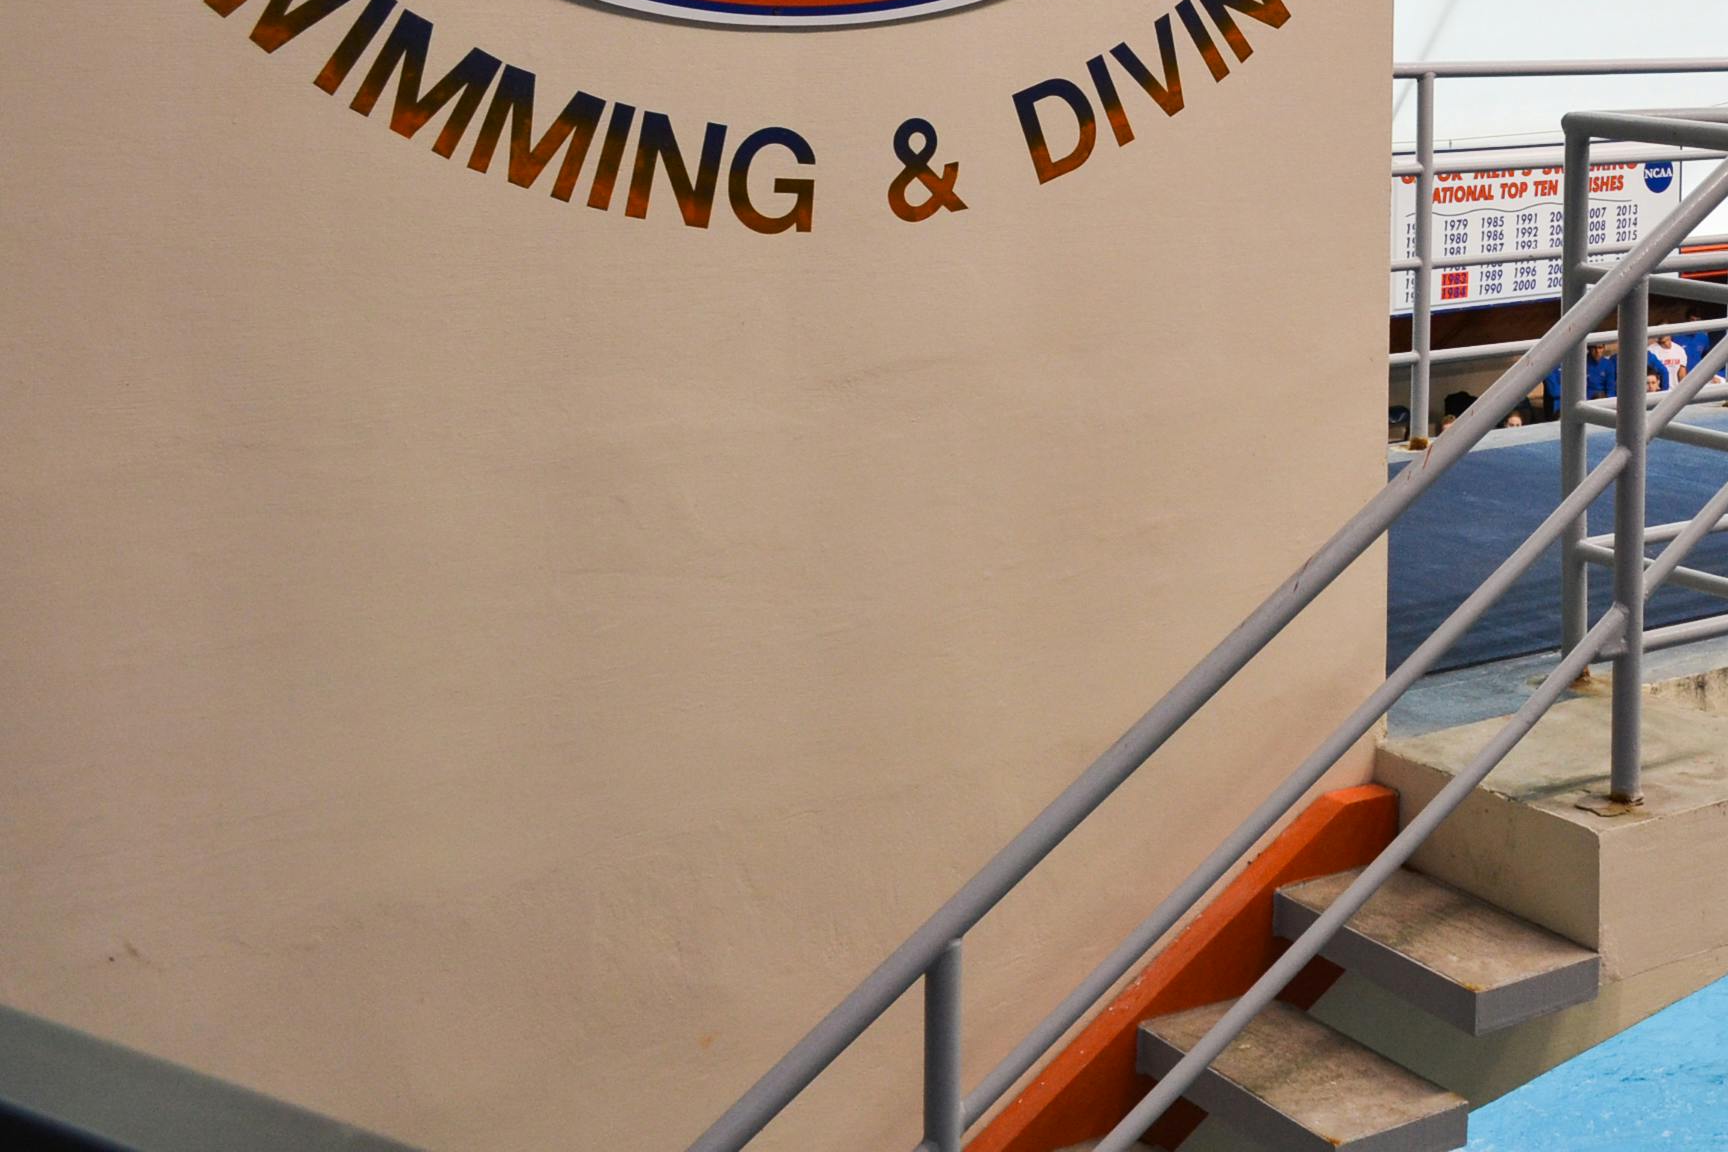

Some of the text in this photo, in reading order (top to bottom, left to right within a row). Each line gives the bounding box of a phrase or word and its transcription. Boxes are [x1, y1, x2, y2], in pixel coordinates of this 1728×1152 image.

[886, 116, 968, 223] &
[1644, 167, 1673, 179] NCAA
[1432, 175, 1624, 204] ATIONAL TOP TEN ISHES
[1589, 207, 1607, 219] 007
[1616, 204, 1638, 217] 2013
[1481, 216, 1504, 228] 1985
[1516, 213, 1538, 225] 1991
[1616, 217, 1638, 230] 2014
[1444, 219, 1468, 232] 1979
[1589, 220, 1606, 232] 008
[1481, 230, 1504, 242] 1986
[1515, 226, 1538, 238] 1992
[1616, 230, 1638, 242] 2015
[1444, 233, 1468, 245] 1980
[1515, 239, 1538, 251] 1993
[1588, 233, 1606, 245] 009
[1480, 269, 1503, 282] 1989
[1514, 266, 1537, 279] 1996
[1442, 273, 1467, 286] 1983
[1512, 279, 1536, 292] 2000
[1441, 286, 1467, 300] 1984
[1479, 283, 1502, 296] 1990
